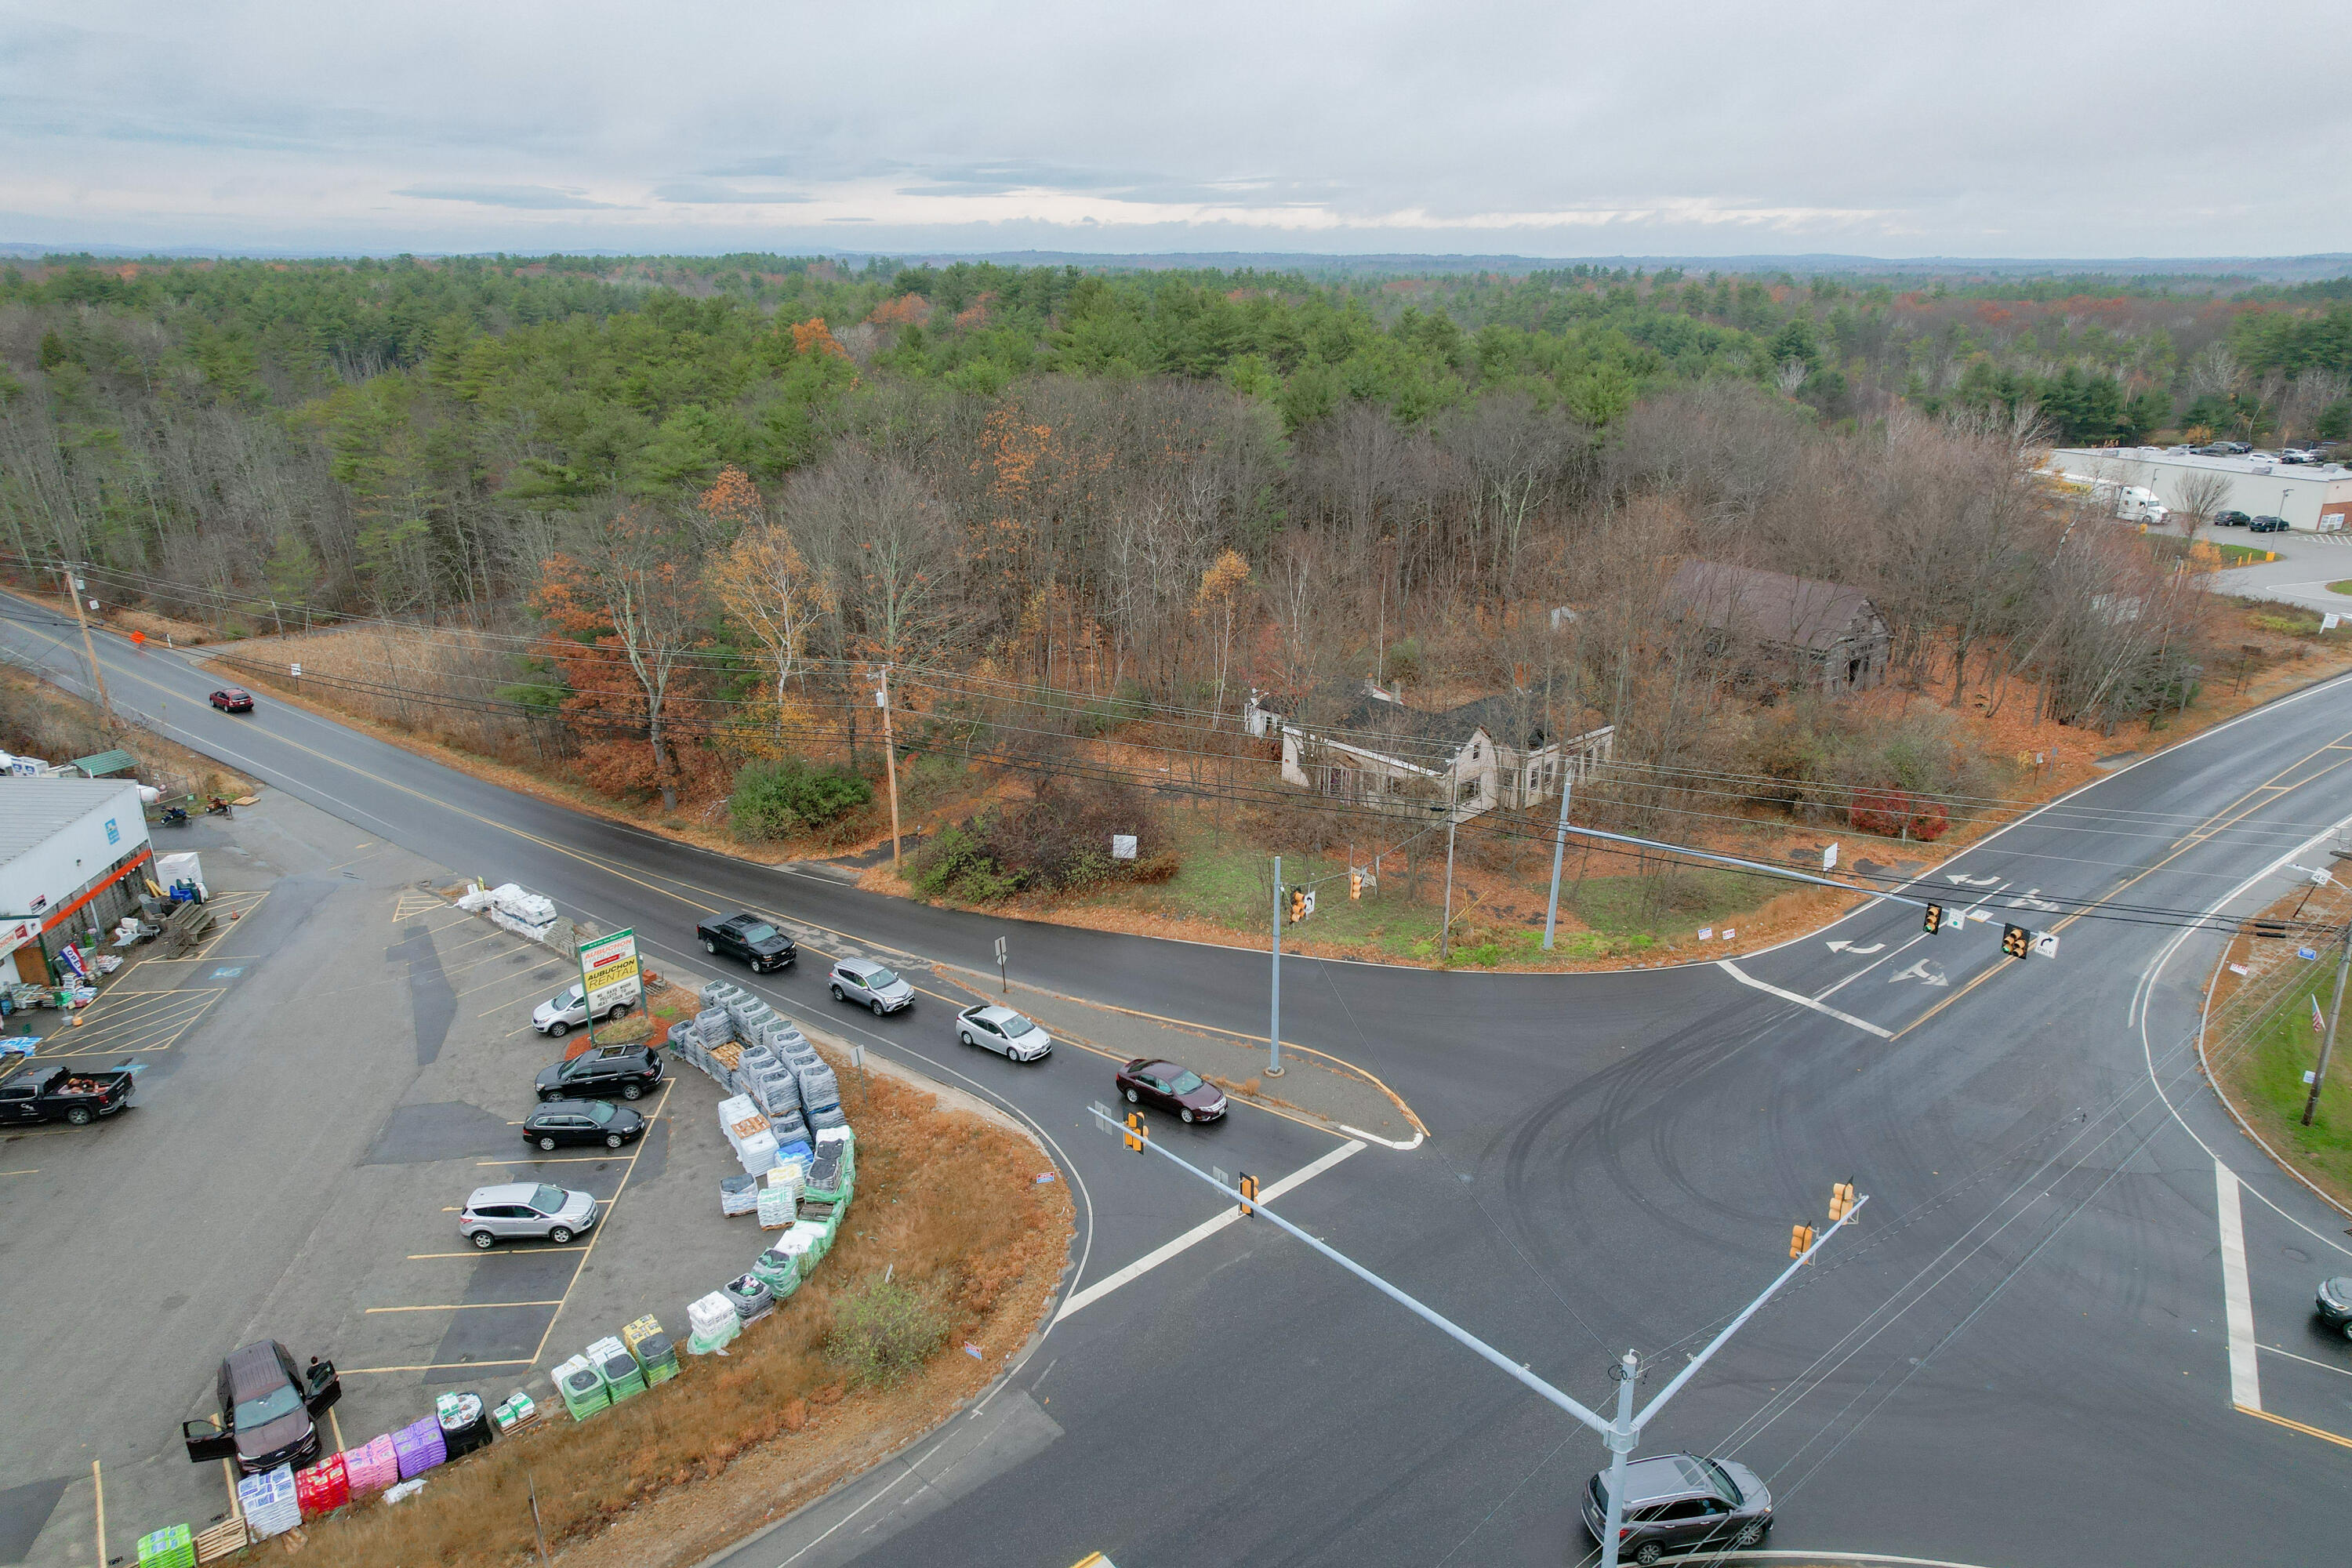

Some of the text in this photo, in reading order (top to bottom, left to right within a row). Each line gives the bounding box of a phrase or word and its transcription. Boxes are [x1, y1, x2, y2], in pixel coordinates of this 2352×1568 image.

[585, 938, 632, 959] AUBUCHON
[588, 959, 635, 981] AUBUCHON
[589, 966, 636, 989] RENTAL
